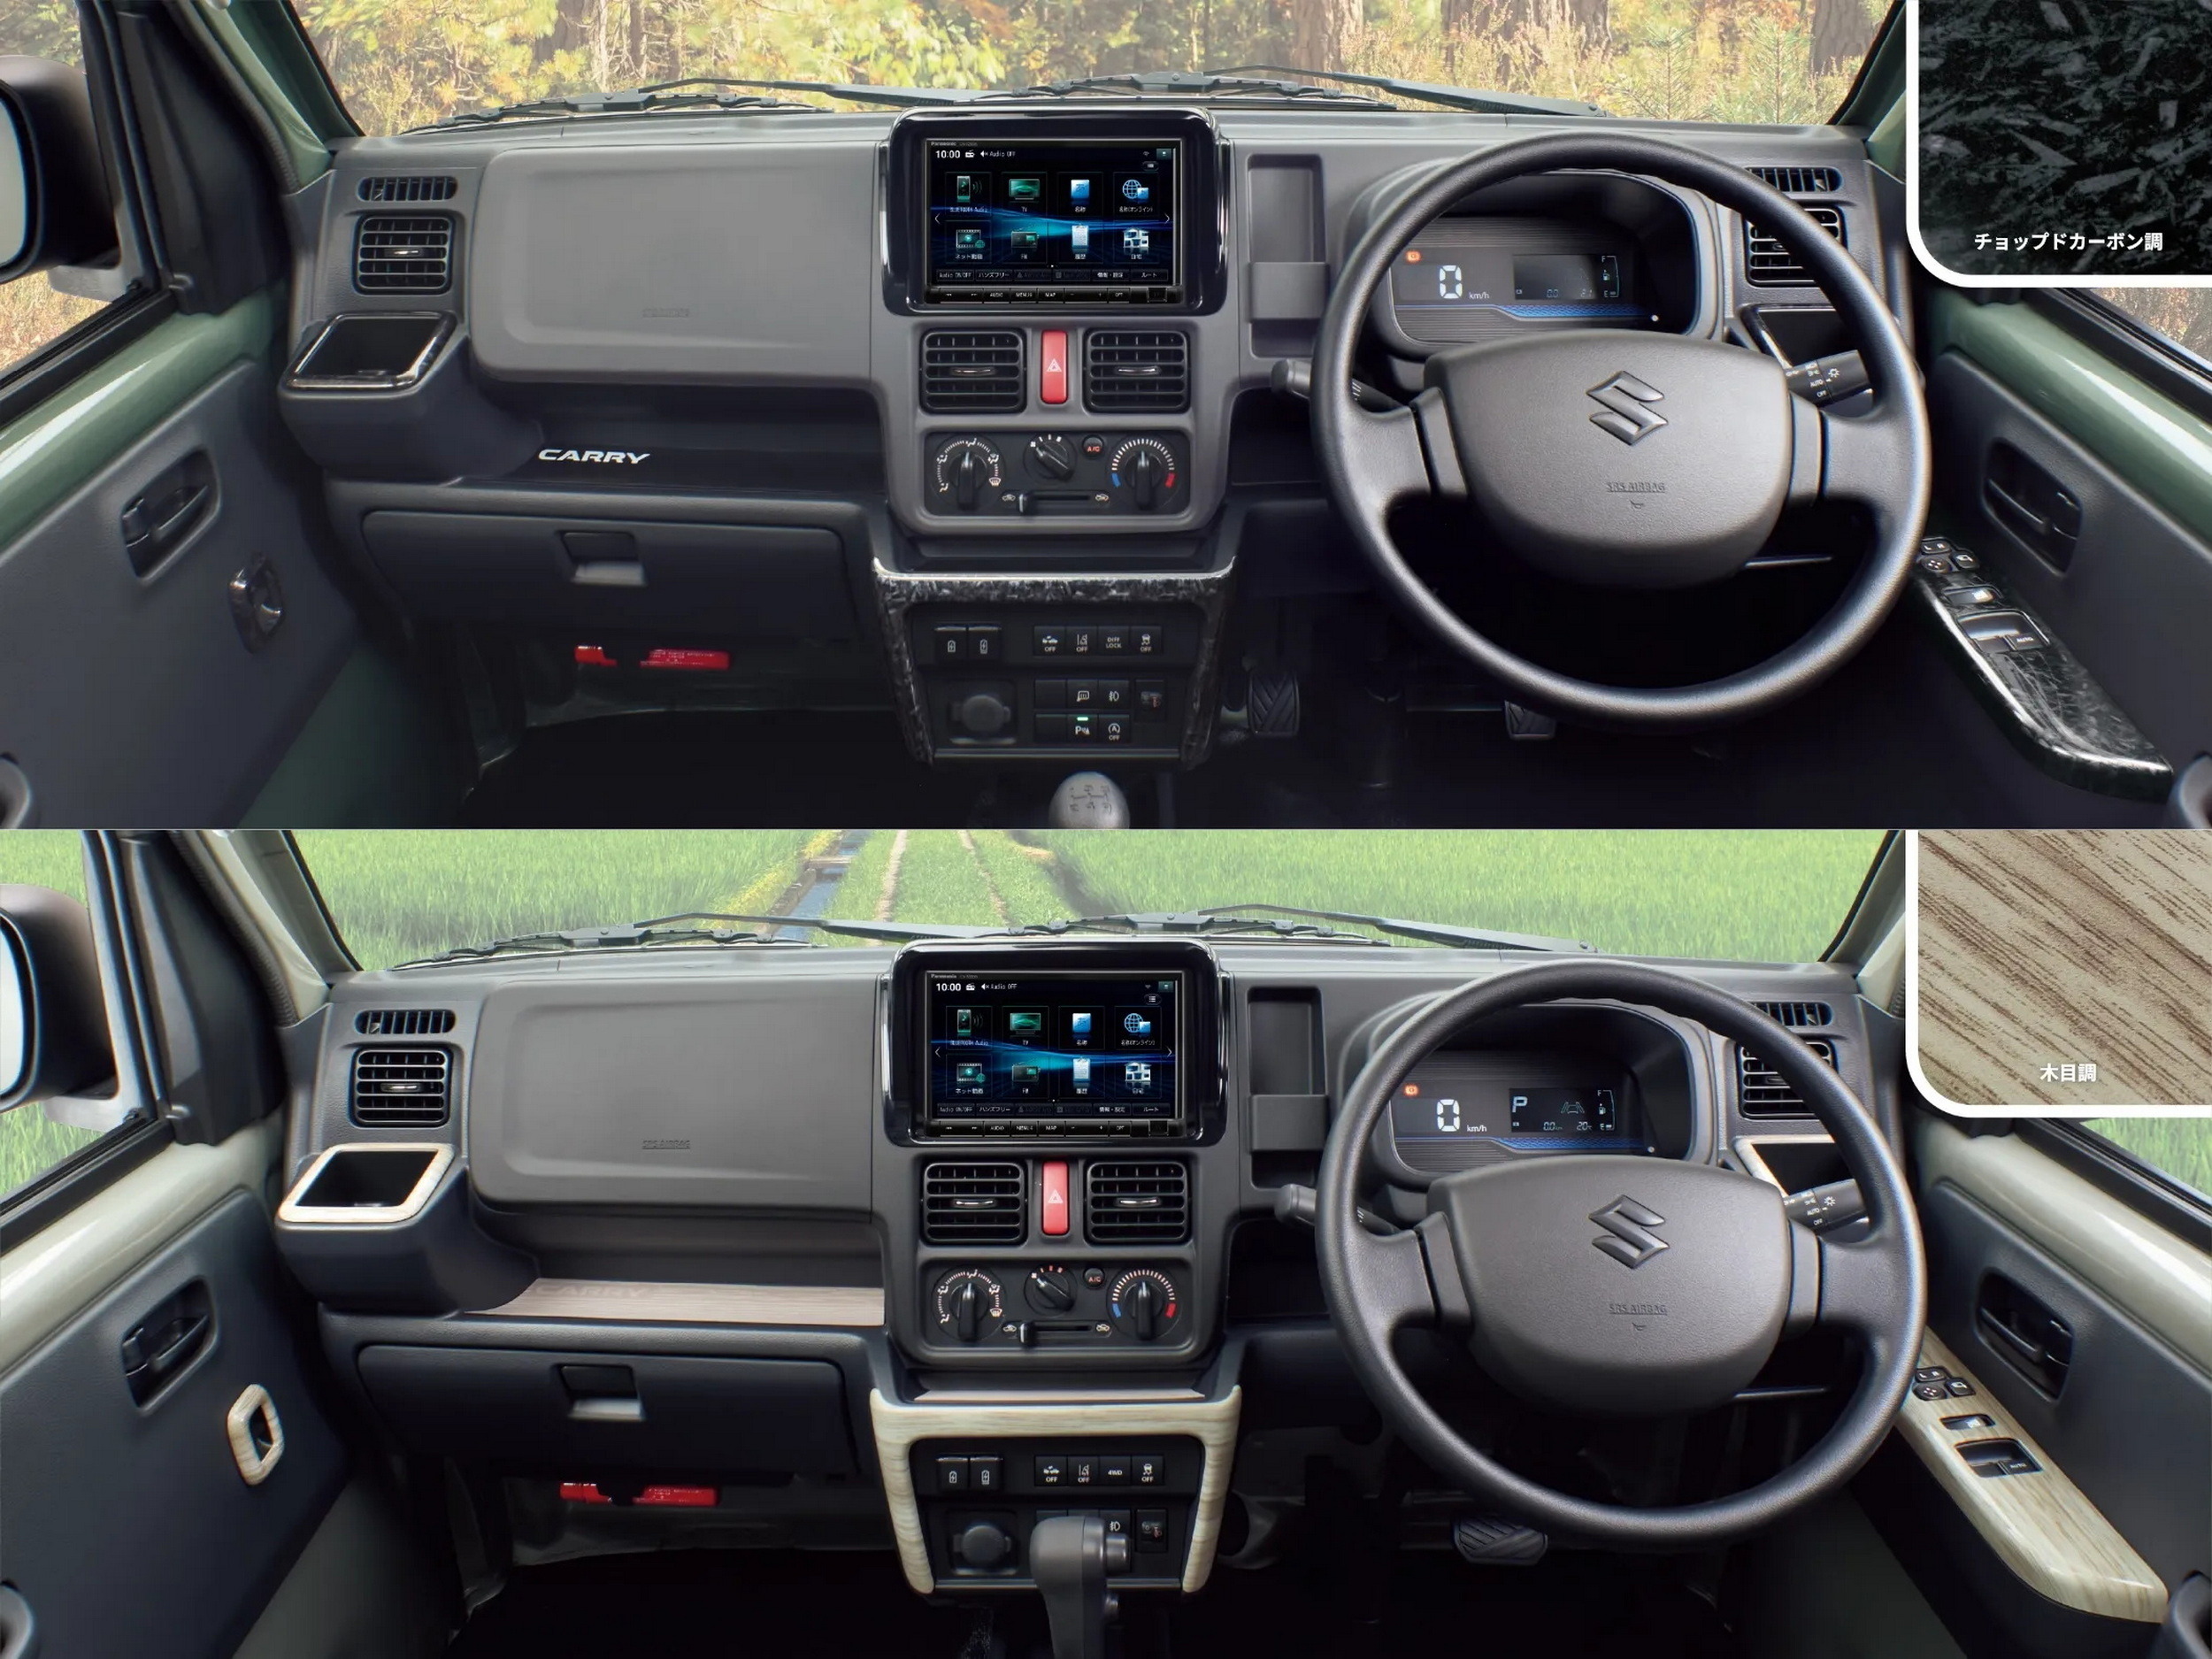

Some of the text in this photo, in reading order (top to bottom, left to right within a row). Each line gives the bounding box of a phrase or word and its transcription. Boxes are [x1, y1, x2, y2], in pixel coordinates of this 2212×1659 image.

[935, 150, 961, 158] 10:00
[1439, 265, 1463, 299] 0
[1809, 379, 1824, 388] AUTO
[538, 449, 650, 465] CARRY
[1628, 482, 1665, 493] AIRBAG
[1512, 1096, 1528, 1113] P
[1436, 1099, 1460, 1132] 0
[1609, 1303, 1667, 1315] SRS AIRBAG
